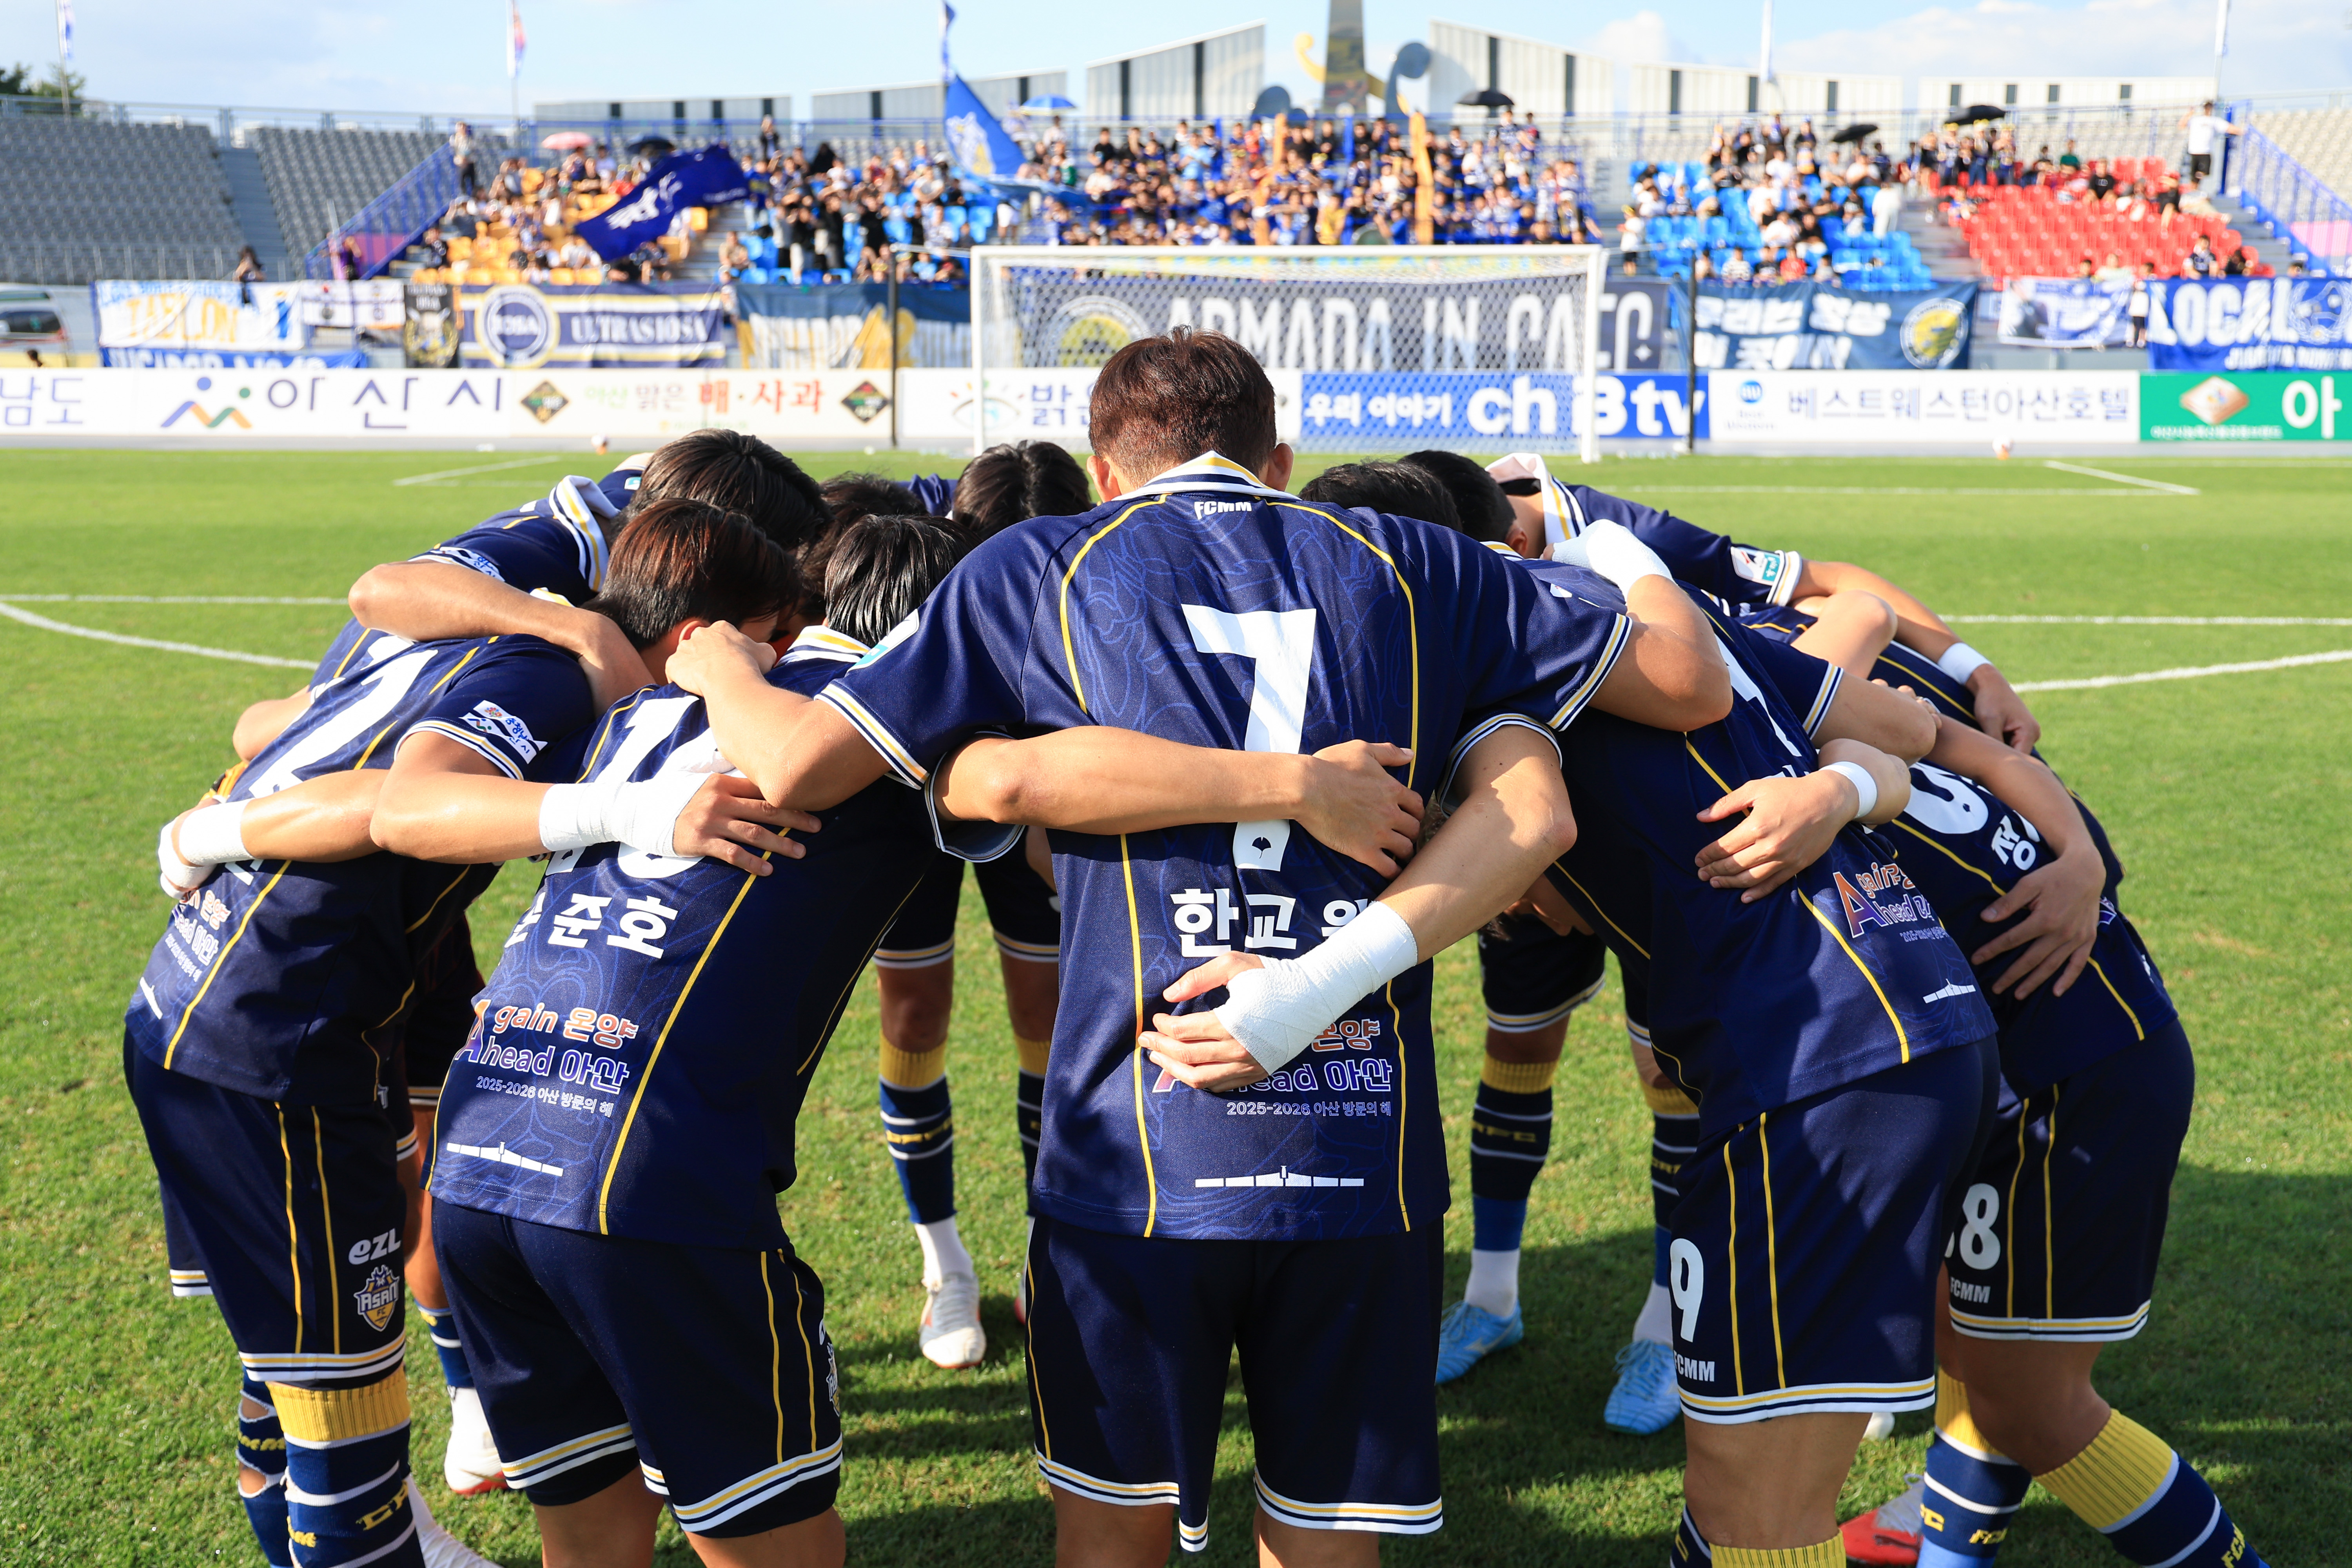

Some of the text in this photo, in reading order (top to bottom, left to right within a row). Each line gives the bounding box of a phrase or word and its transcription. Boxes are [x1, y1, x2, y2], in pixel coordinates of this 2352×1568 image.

[268, 376, 501, 428] 아산시
[635, 383, 687, 411] 맑은
[1031, 384, 1093, 426] 밝
[1303, 391, 1452, 428] 우리 이야기
[1466, 374, 1558, 436] ch
[2281, 375, 2343, 439] 아
[1194, 501, 1252, 520] FCMM
[1182, 603, 1316, 872] 7
[563, 1007, 640, 1050] 온양
[559, 1050, 630, 1095] 아산
[1324, 1057, 1392, 1092] 아산
[475, 1076, 614, 1118] 2025-2026 아산 방문의 해
[1227, 1101, 1392, 1117] 2025-2026 아산 방문의 해
[1945, 1183, 2001, 1270] 8
[1670, 1238, 1704, 1343] 9
